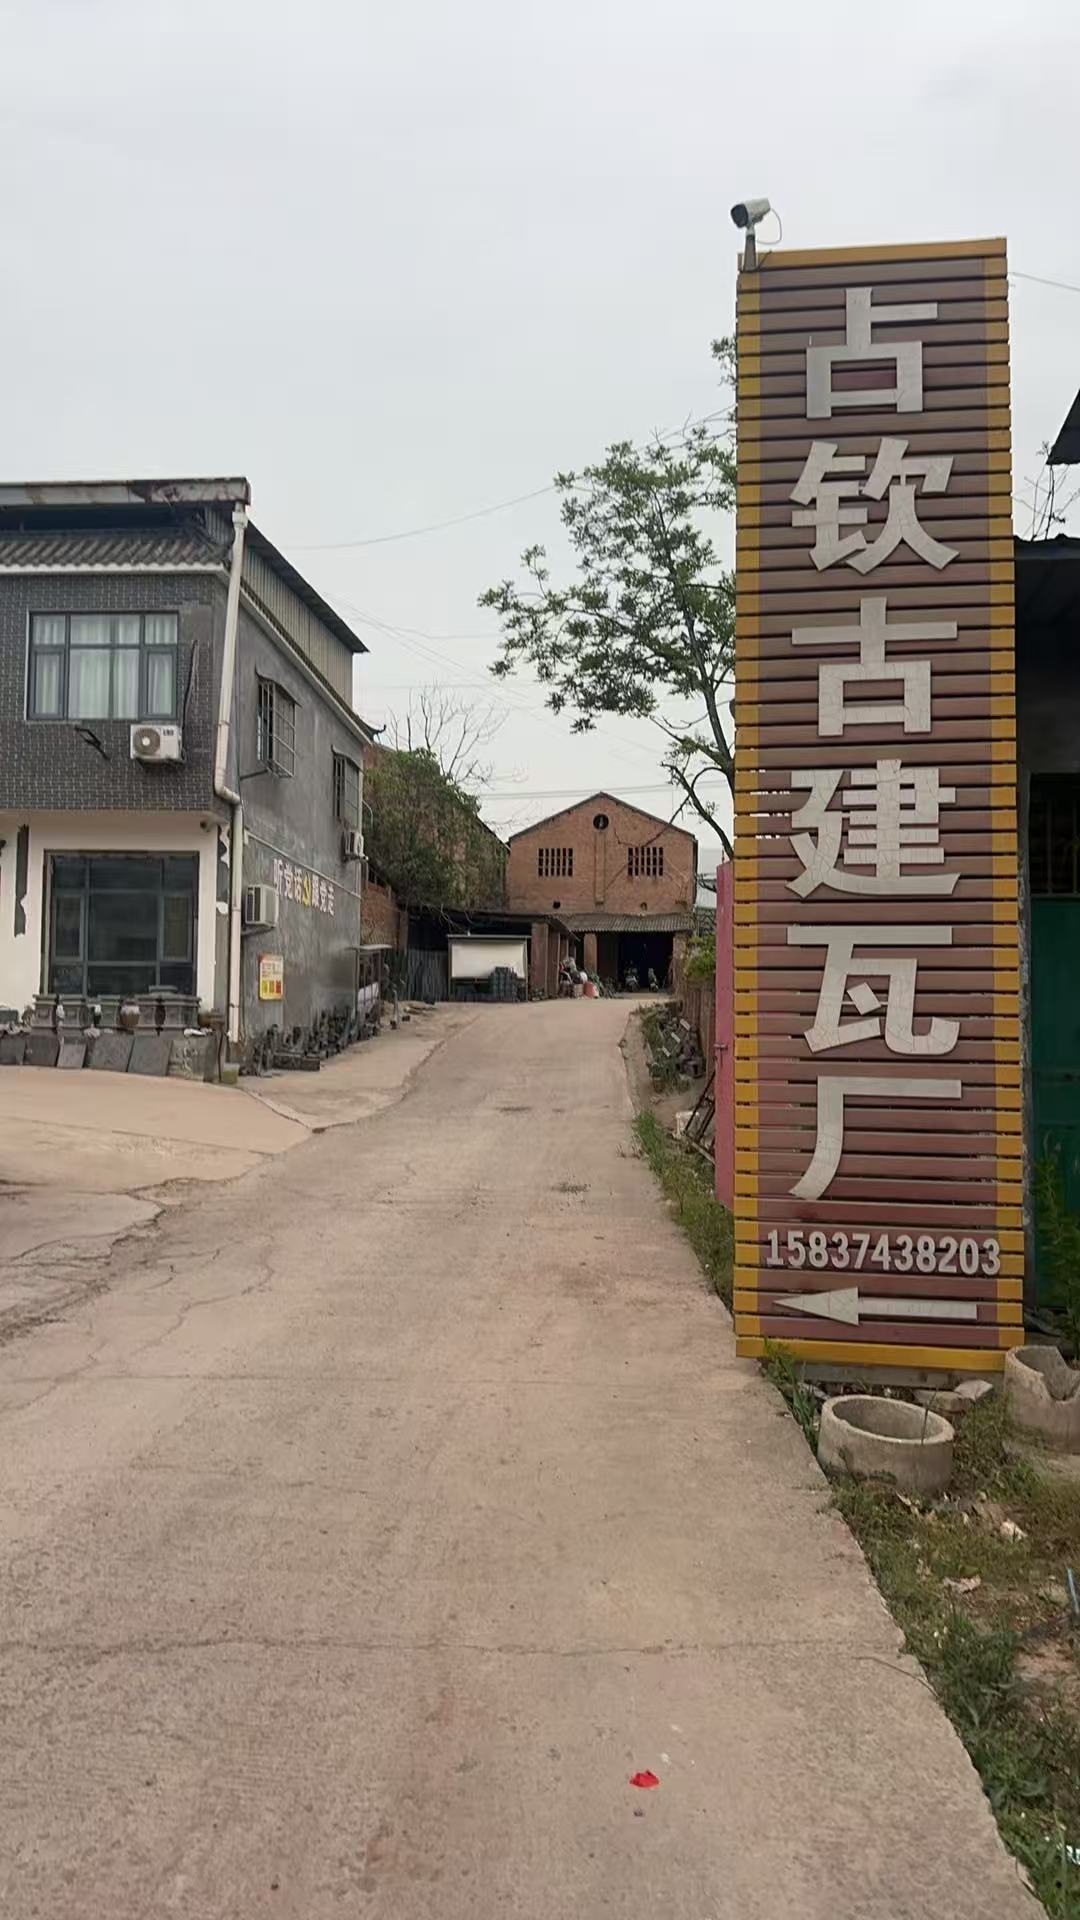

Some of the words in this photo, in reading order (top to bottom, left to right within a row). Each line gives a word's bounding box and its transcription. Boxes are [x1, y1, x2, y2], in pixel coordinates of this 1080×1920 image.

[785, 286, 963, 1201] 占钦古建瓦厂
[765, 1228, 1002, 1277] 15837438203
